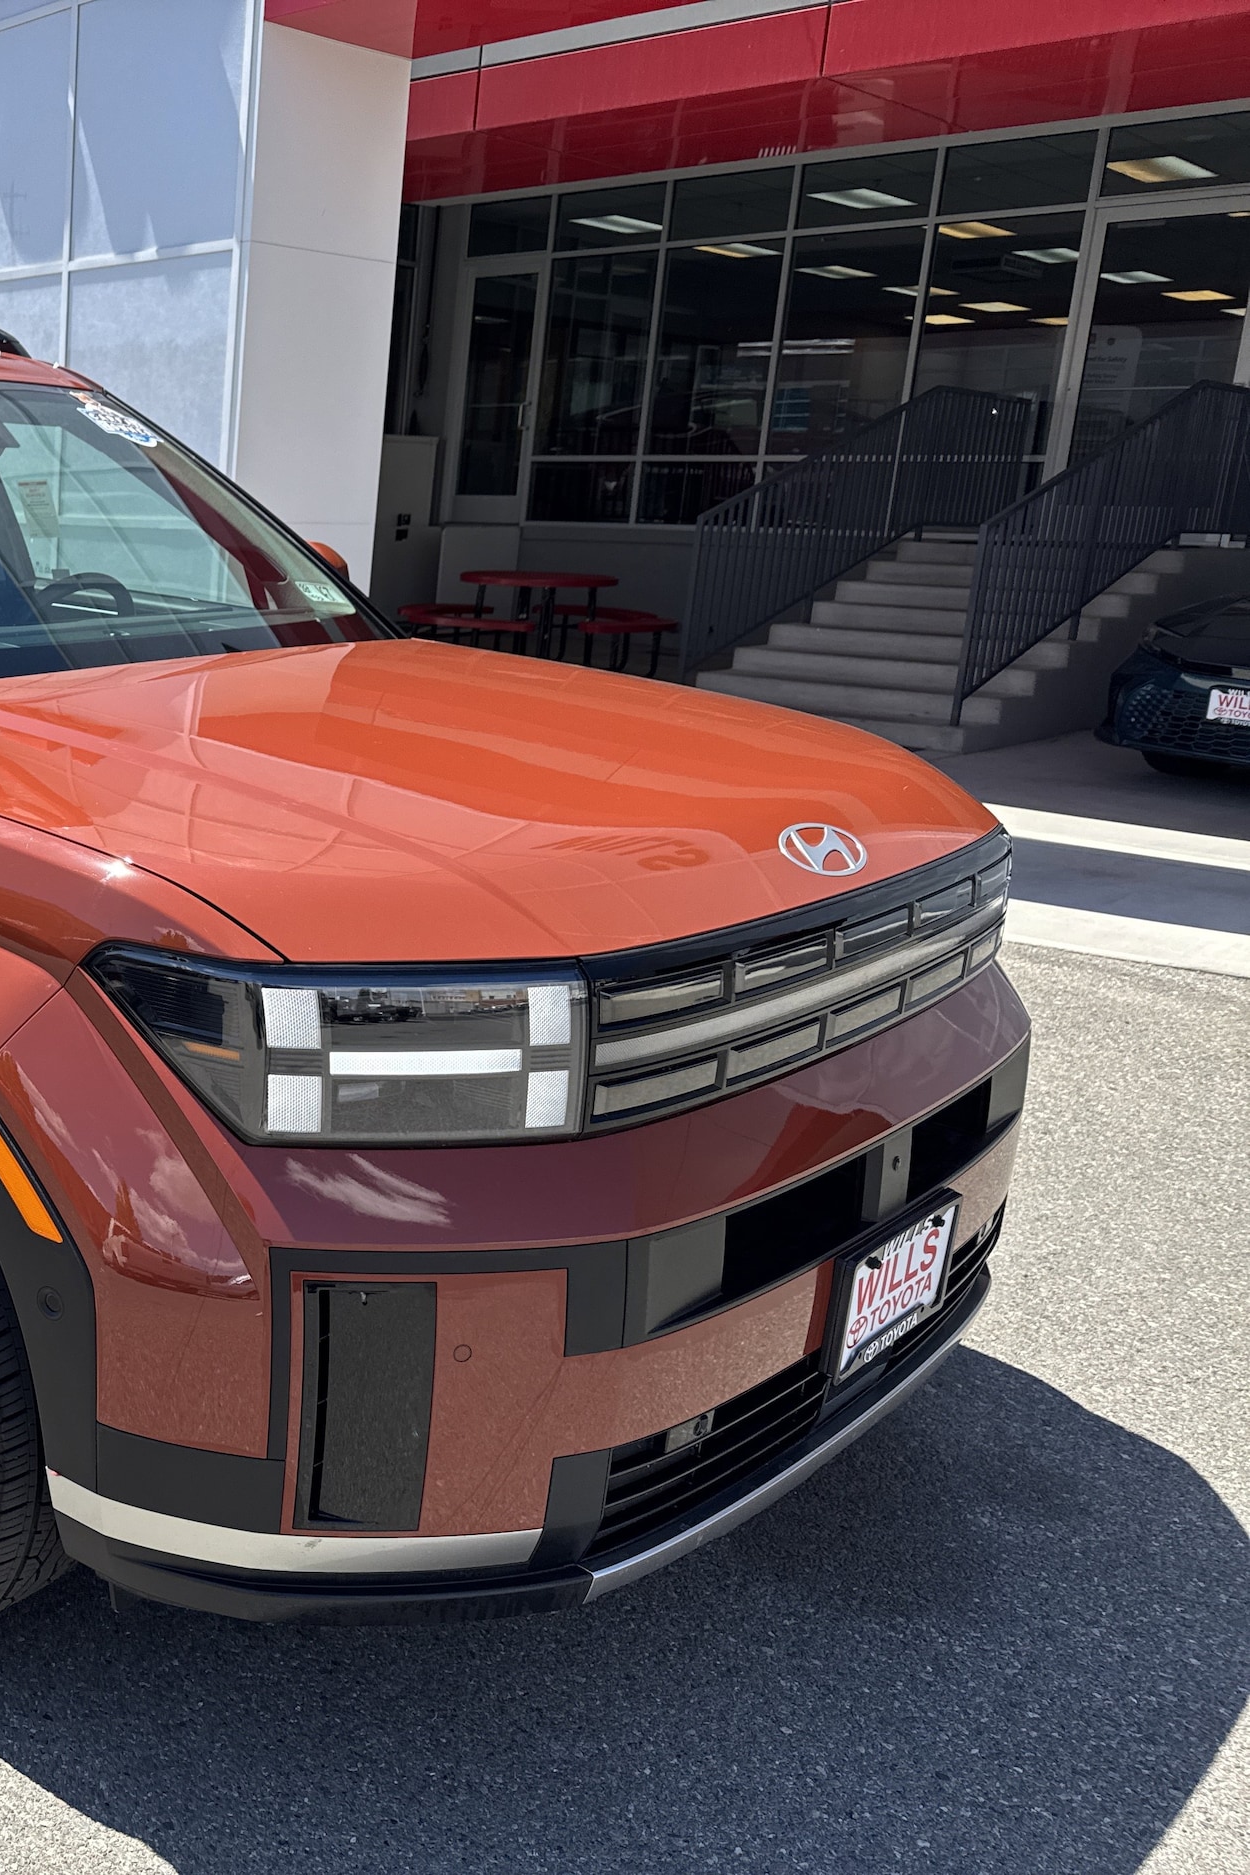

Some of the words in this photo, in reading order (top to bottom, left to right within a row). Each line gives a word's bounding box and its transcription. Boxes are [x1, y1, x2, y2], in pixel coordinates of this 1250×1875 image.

[1218, 694, 1250, 710] WIL
[1228, 688, 1250, 697] WIL
[857, 1228, 940, 1316] WILLS
[870, 1272, 932, 1332] TOYOTA
[879, 1312, 919, 1347] TOYOTA
